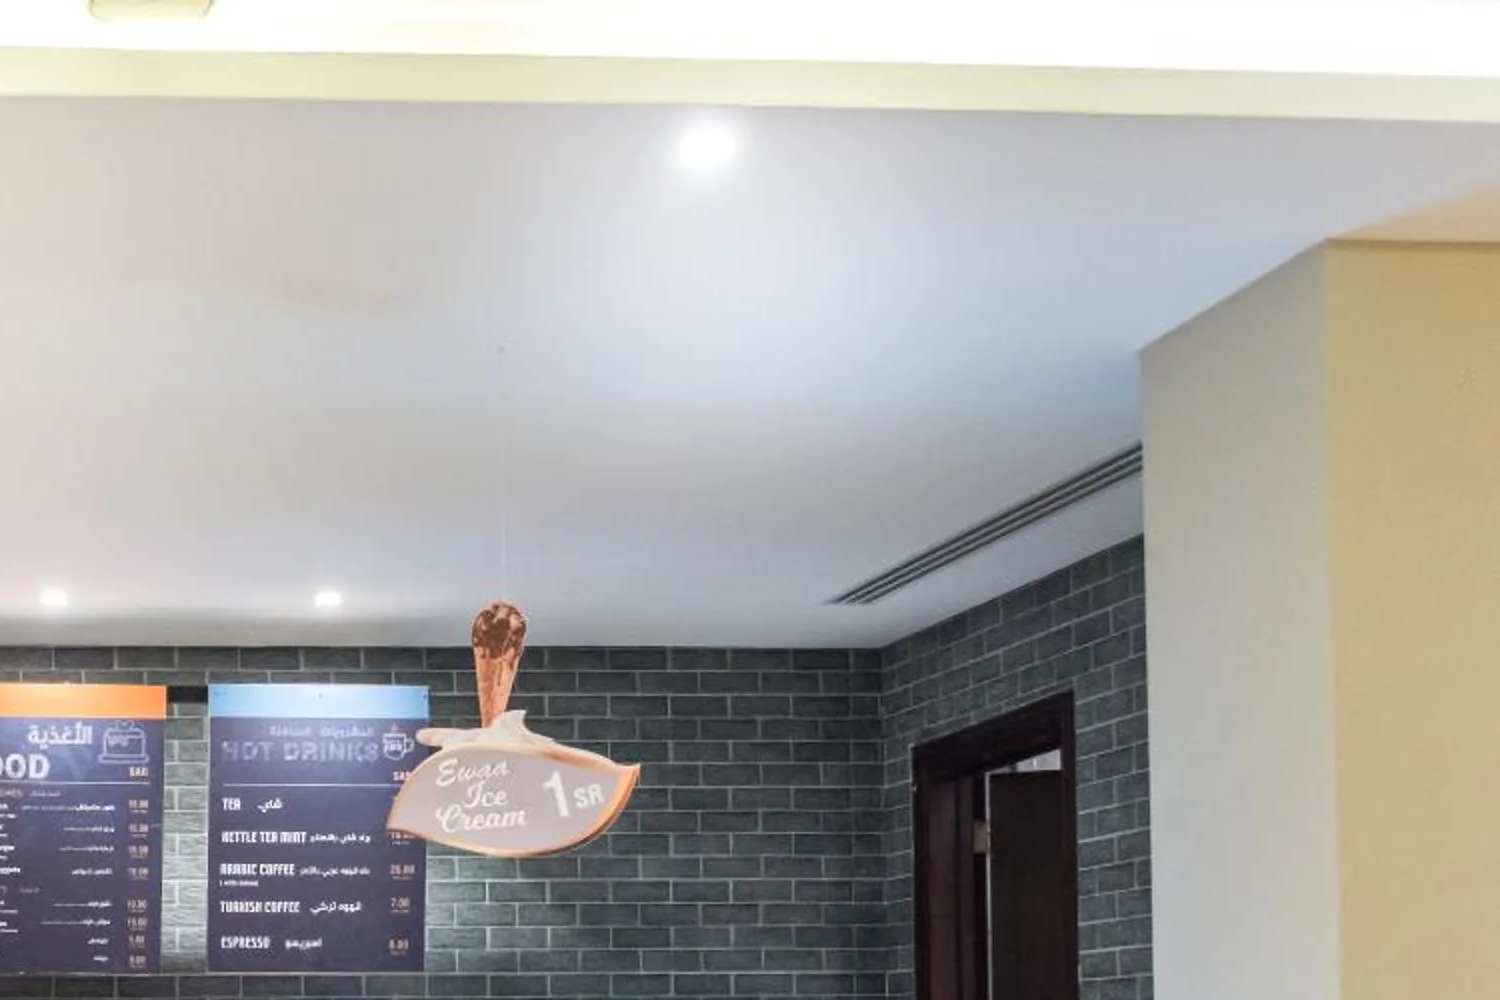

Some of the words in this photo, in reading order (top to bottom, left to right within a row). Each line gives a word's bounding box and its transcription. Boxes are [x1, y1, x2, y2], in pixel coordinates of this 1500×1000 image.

[221, 740, 275, 761] HOT
[283, 740, 380, 762] DRINKS
[436, 758, 510, 787] Ewaa
[464, 781, 508, 808] Ice
[542, 771, 569, 817] 1
[573, 784, 606, 809] SR
[222, 797, 241, 811] TEA
[257, 797, 283, 813] شاي
[435, 805, 527, 833] Cream
[221, 831, 257, 843] KETTLE
[259, 831, 279, 843] TEA
[279, 831, 307, 843] MINT
[220, 863, 257, 875] ARABIC
[259, 863, 295, 875] COFFEE
[220, 901, 262, 913] TURKISH
[264, 901, 300, 913] COFFEE
[220, 936, 270, 949] ESPRESSO
